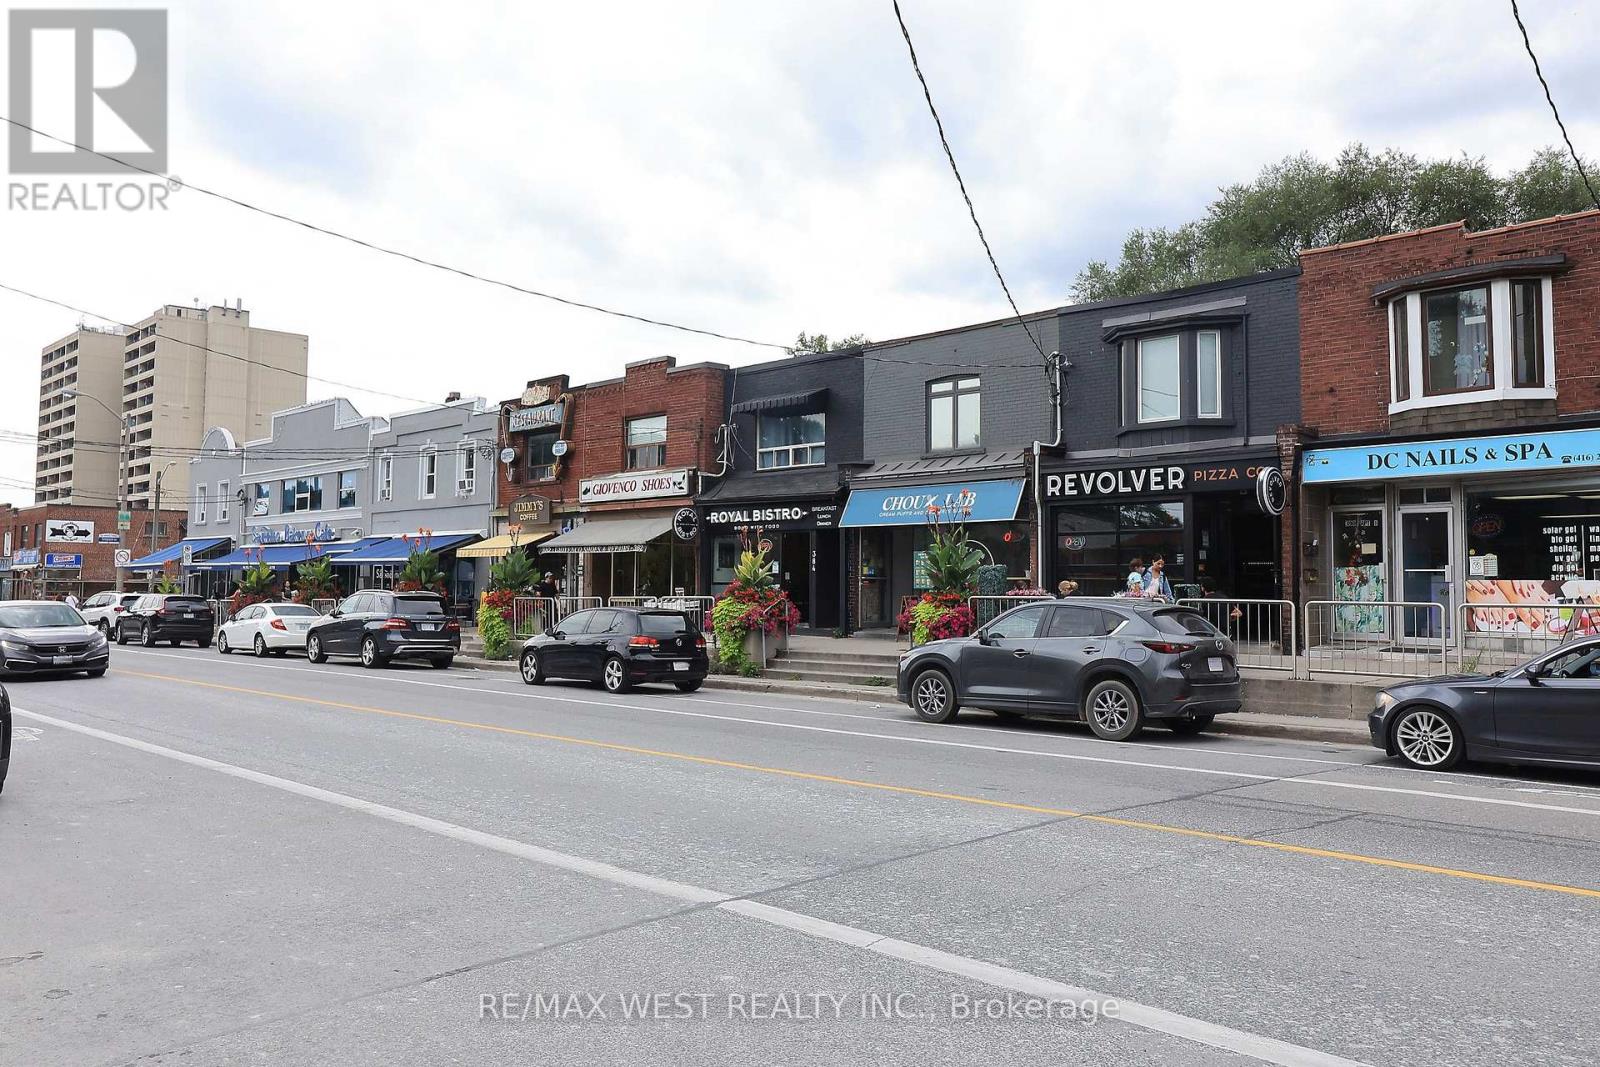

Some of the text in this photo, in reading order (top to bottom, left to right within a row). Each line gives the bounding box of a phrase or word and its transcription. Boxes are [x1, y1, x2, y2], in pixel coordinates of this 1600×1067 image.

[1367, 442, 1554, 470] DC NAILS & SPA
[1573, 454, 1594, 462] (416)
[593, 477, 672, 496] GIOVENCO SHOES
[1047, 466, 1186, 497] REVOLVER
[1194, 468, 1239, 482] PIZZA
[943, 491, 977, 508] LAB
[513, 500, 544, 513] JIMMY'S
[677, 510, 697, 522] ROYAL
[710, 507, 801, 524] ROYAL BISTRO
[677, 526, 697, 538] BISTRO
[1542, 525, 1577, 535] solar gel
[1565, 535, 1577, 544] gel
[1549, 545, 1578, 553] shellac
[1565, 554, 1578, 563] gel
[1566, 563, 1579, 573] gel
